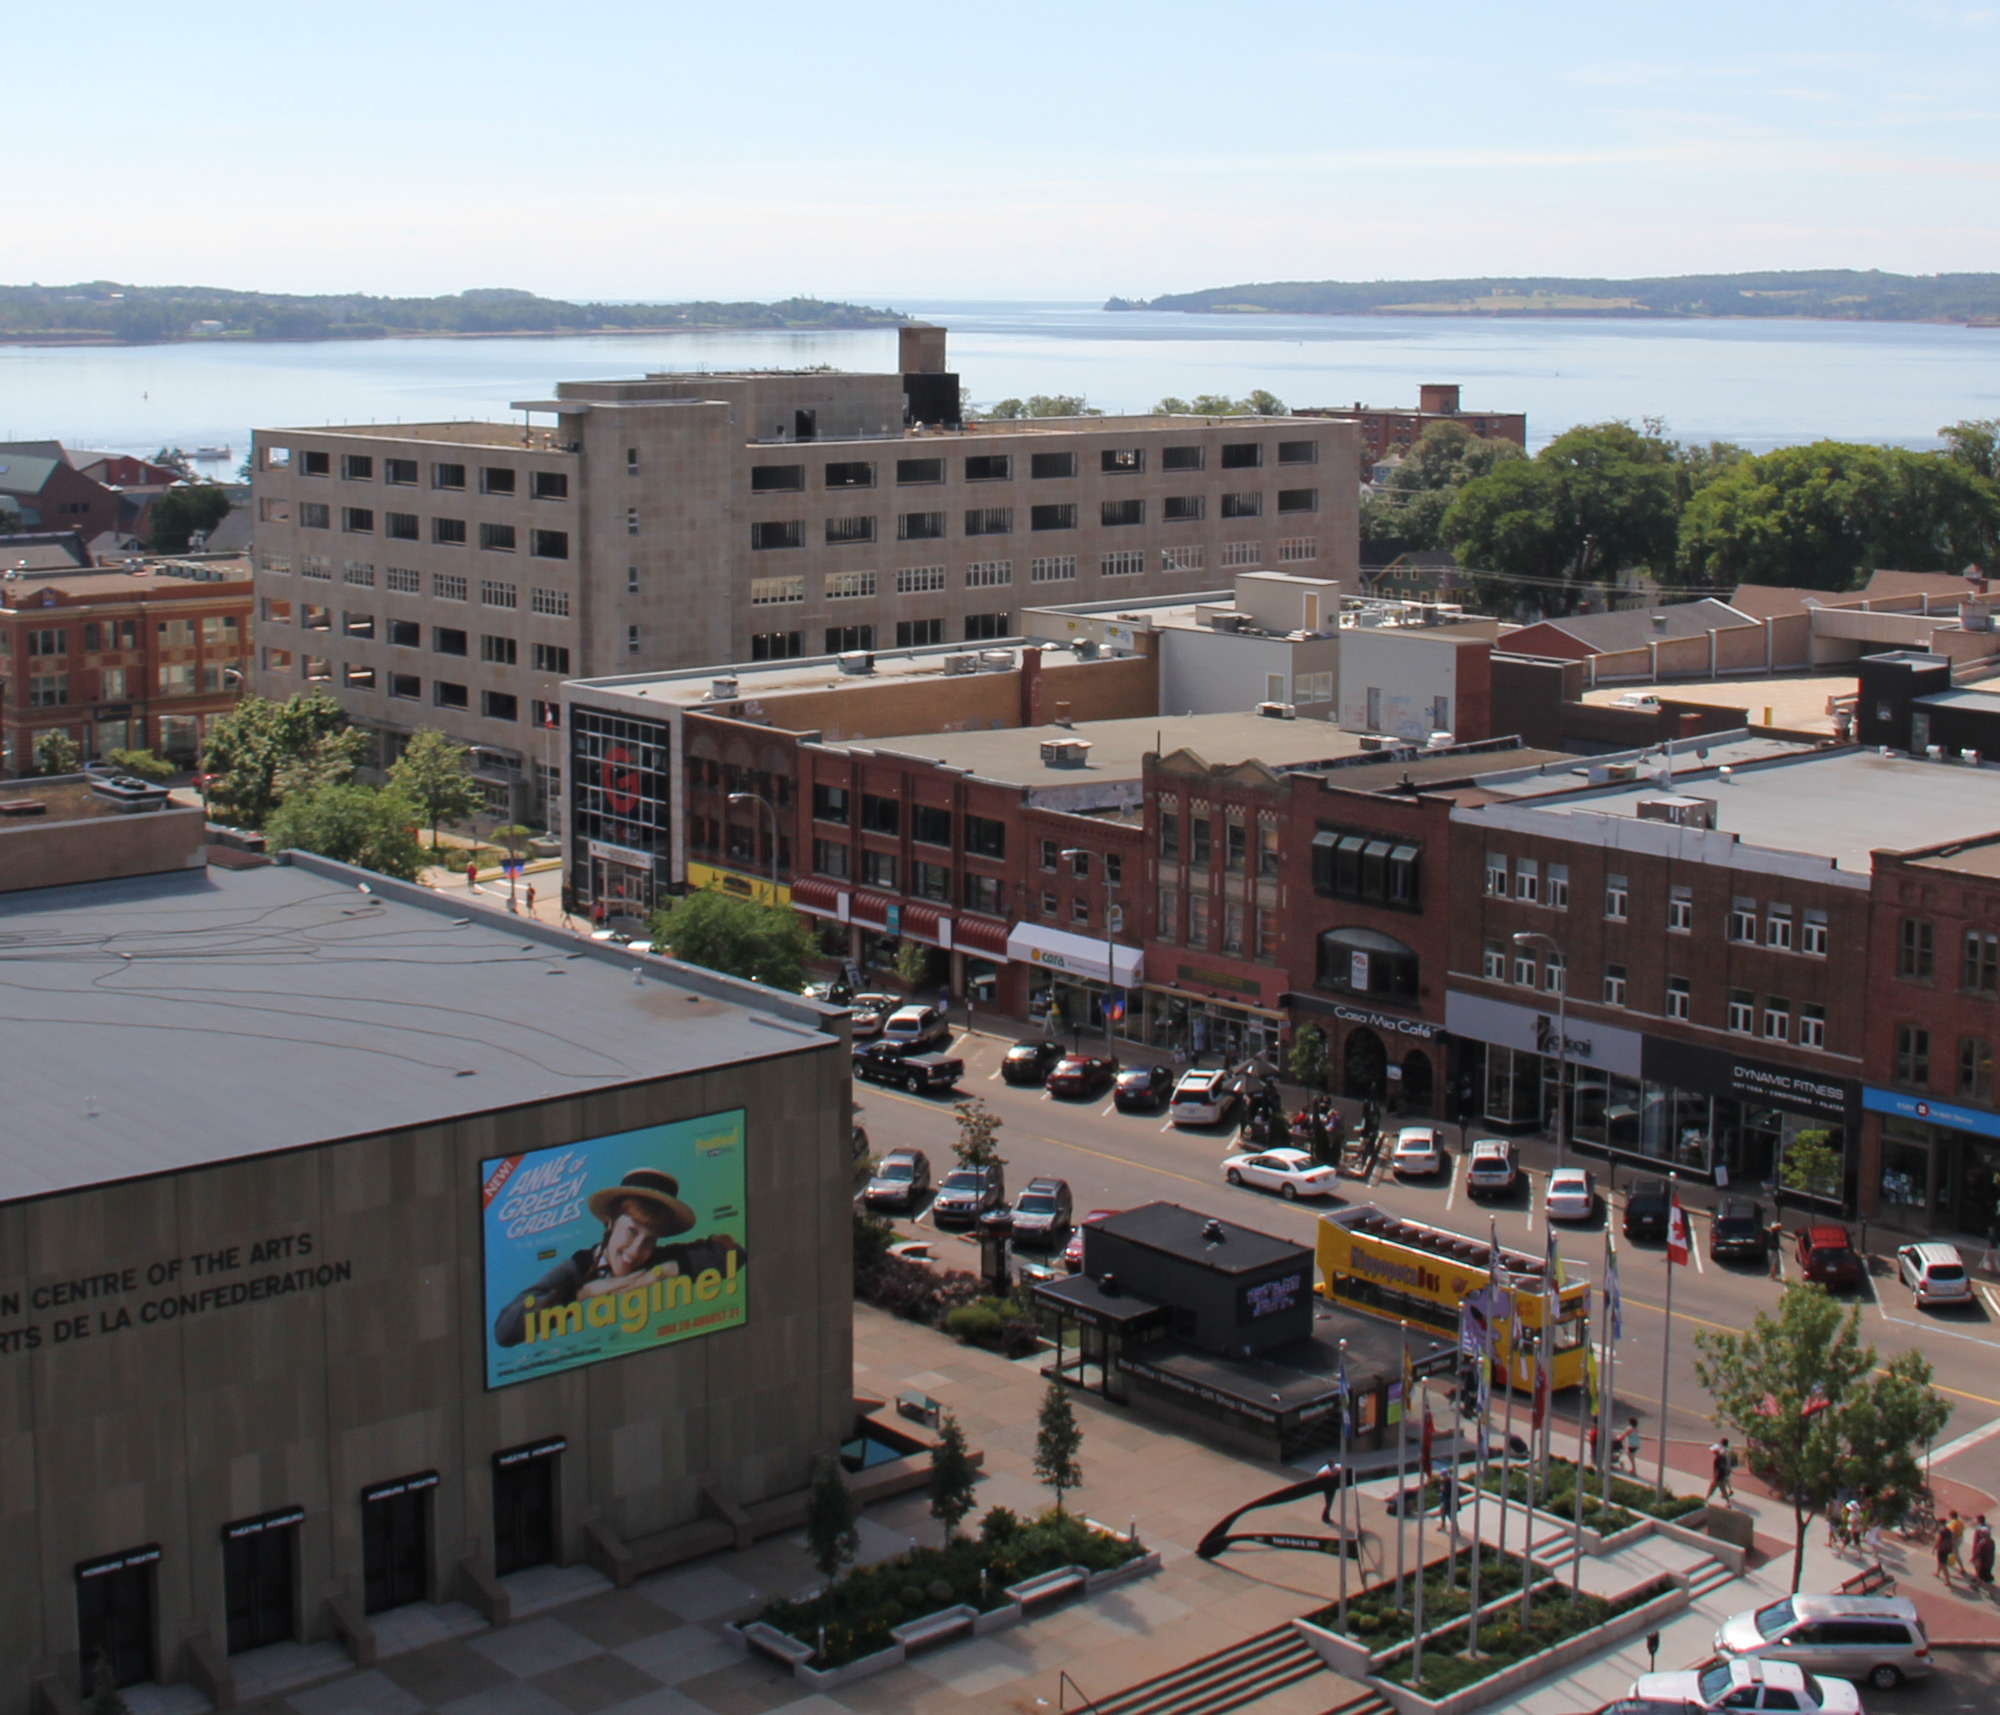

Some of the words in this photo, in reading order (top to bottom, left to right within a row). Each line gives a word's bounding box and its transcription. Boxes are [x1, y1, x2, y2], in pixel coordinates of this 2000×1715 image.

[603, 747, 639, 813] G
[1042, 952, 1065, 968] cora
[1334, 1006, 1367, 1023] Casa
[1369, 1014, 1396, 1030] Mia
[1397, 1020, 1431, 1038] Café
[1733, 1066, 1791, 1088] DYNAMIC
[1793, 1080, 1844, 1100] FITNESS
[484, 1161, 514, 1197] NEW!
[498, 1171, 589, 1222] GREEN
[507, 1151, 575, 1198] ANNE
[506, 1197, 585, 1239] GABLES
[32, 1268, 138, 1310] CENTRE
[147, 1257, 182, 1286] OF
[191, 1246, 241, 1276] THE
[249, 1233, 313, 1265] ARTS
[54, 1315, 91, 1343] DE
[101, 1307, 131, 1333] LA
[140, 1260, 351, 1324] CONFEDERATION
[523, 1250, 738, 1344] imagine!
